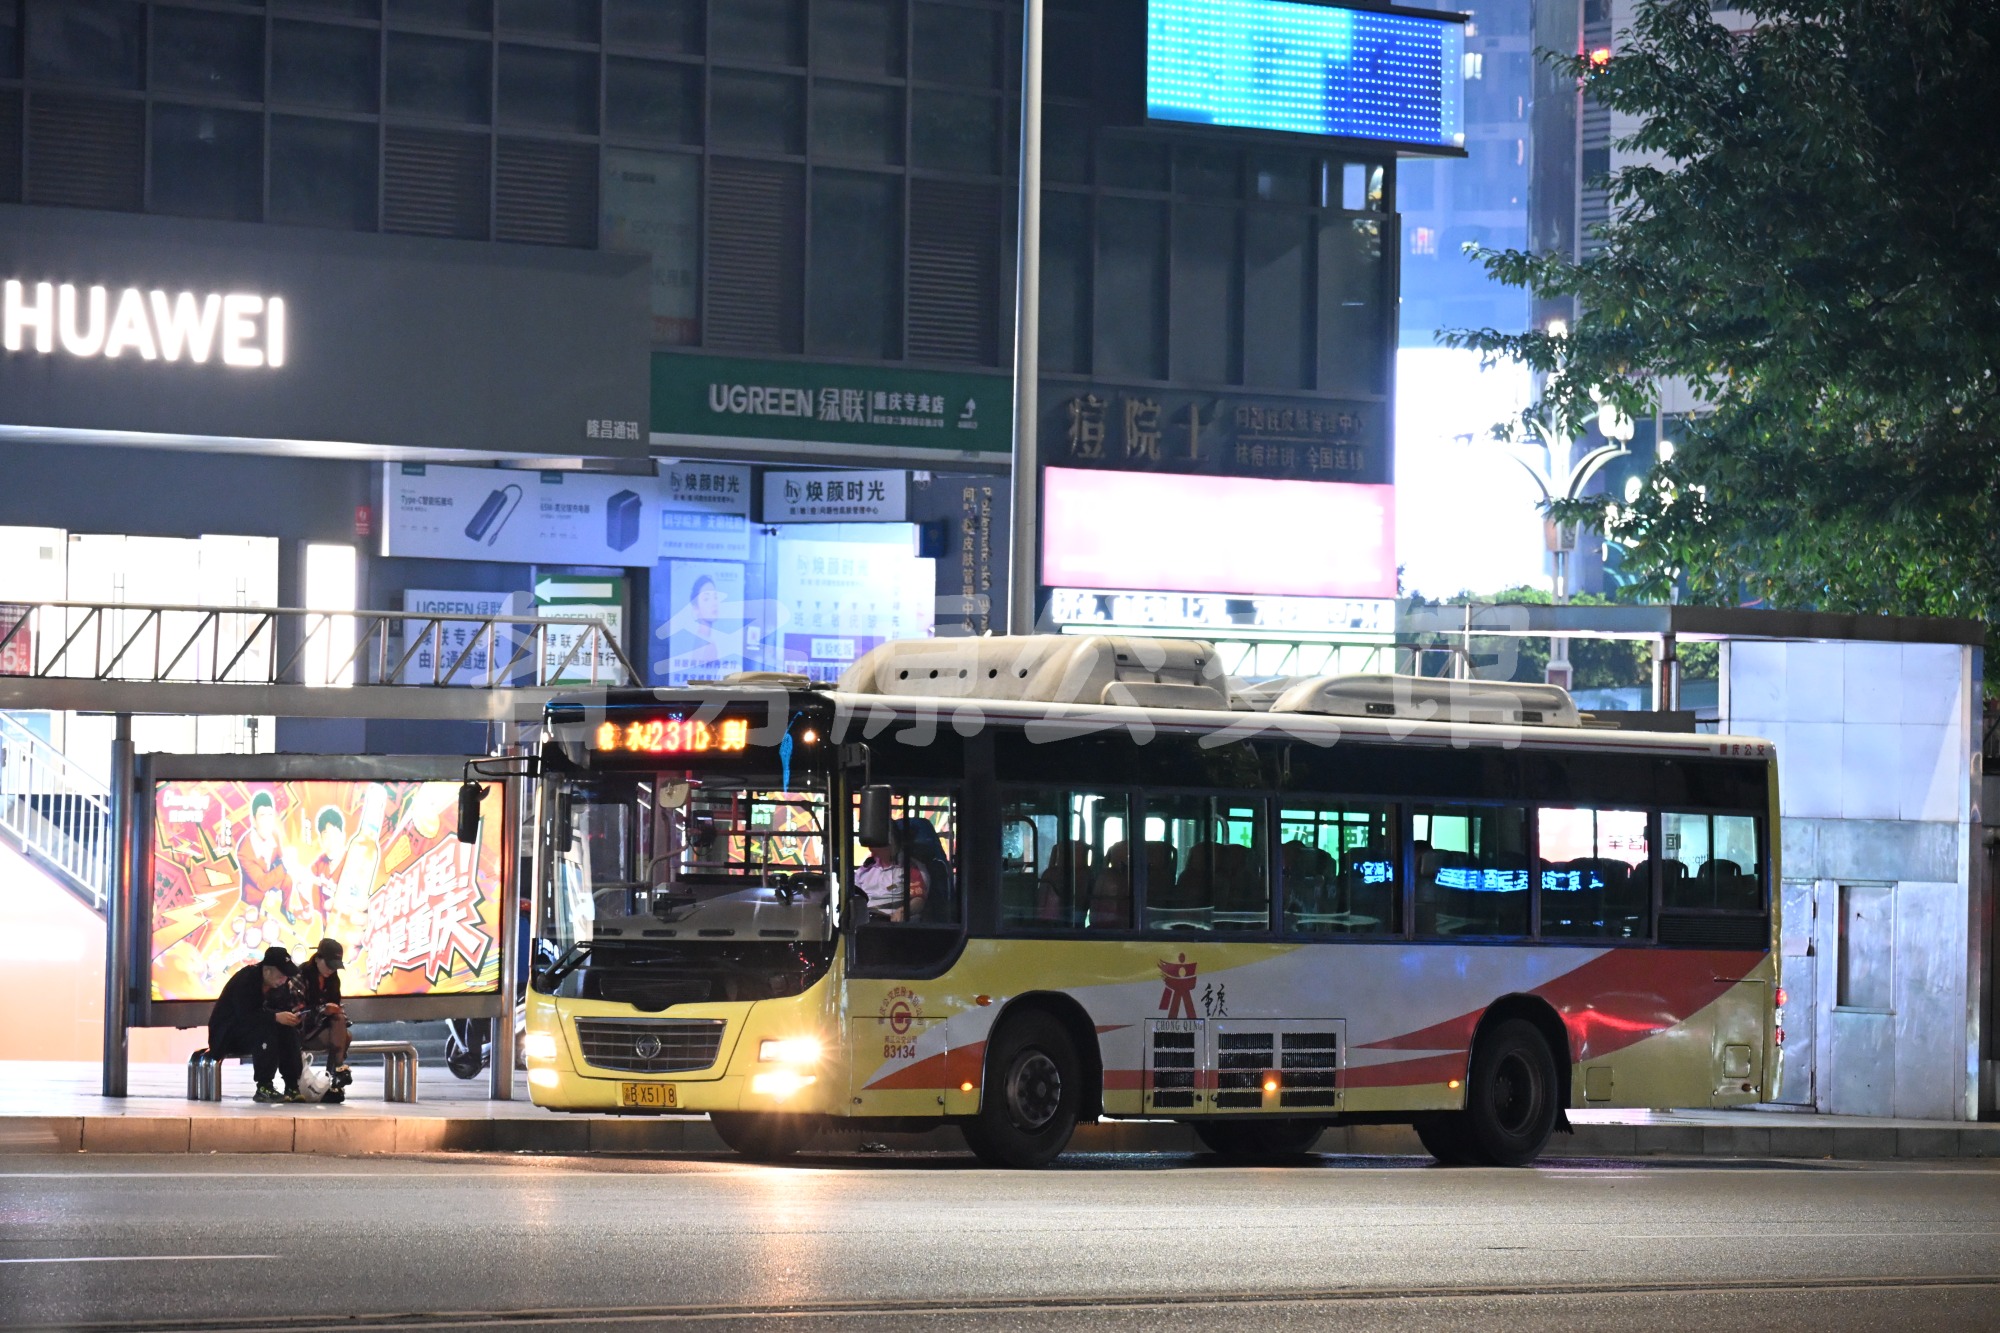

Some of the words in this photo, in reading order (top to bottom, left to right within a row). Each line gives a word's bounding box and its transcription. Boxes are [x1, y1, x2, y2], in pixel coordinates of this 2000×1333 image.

[4, 279, 285, 367] HUAWEI
[708, 383, 813, 418] UGREEN
[817, 387, 867, 423] 绿联
[874, 391, 945, 414] 重庆专卖店
[586, 419, 640, 440] 隆昌通讯
[685, 472, 739, 493] 焕颜时光
[806, 480, 885, 502] 焕颜时光
[1720, 743, 1764, 756] 重庆公交
[1155, 1020, 1181, 1032] CHONG
[1183, 1021, 1204, 1033] QING
[884, 1044, 915, 1058] 83134
